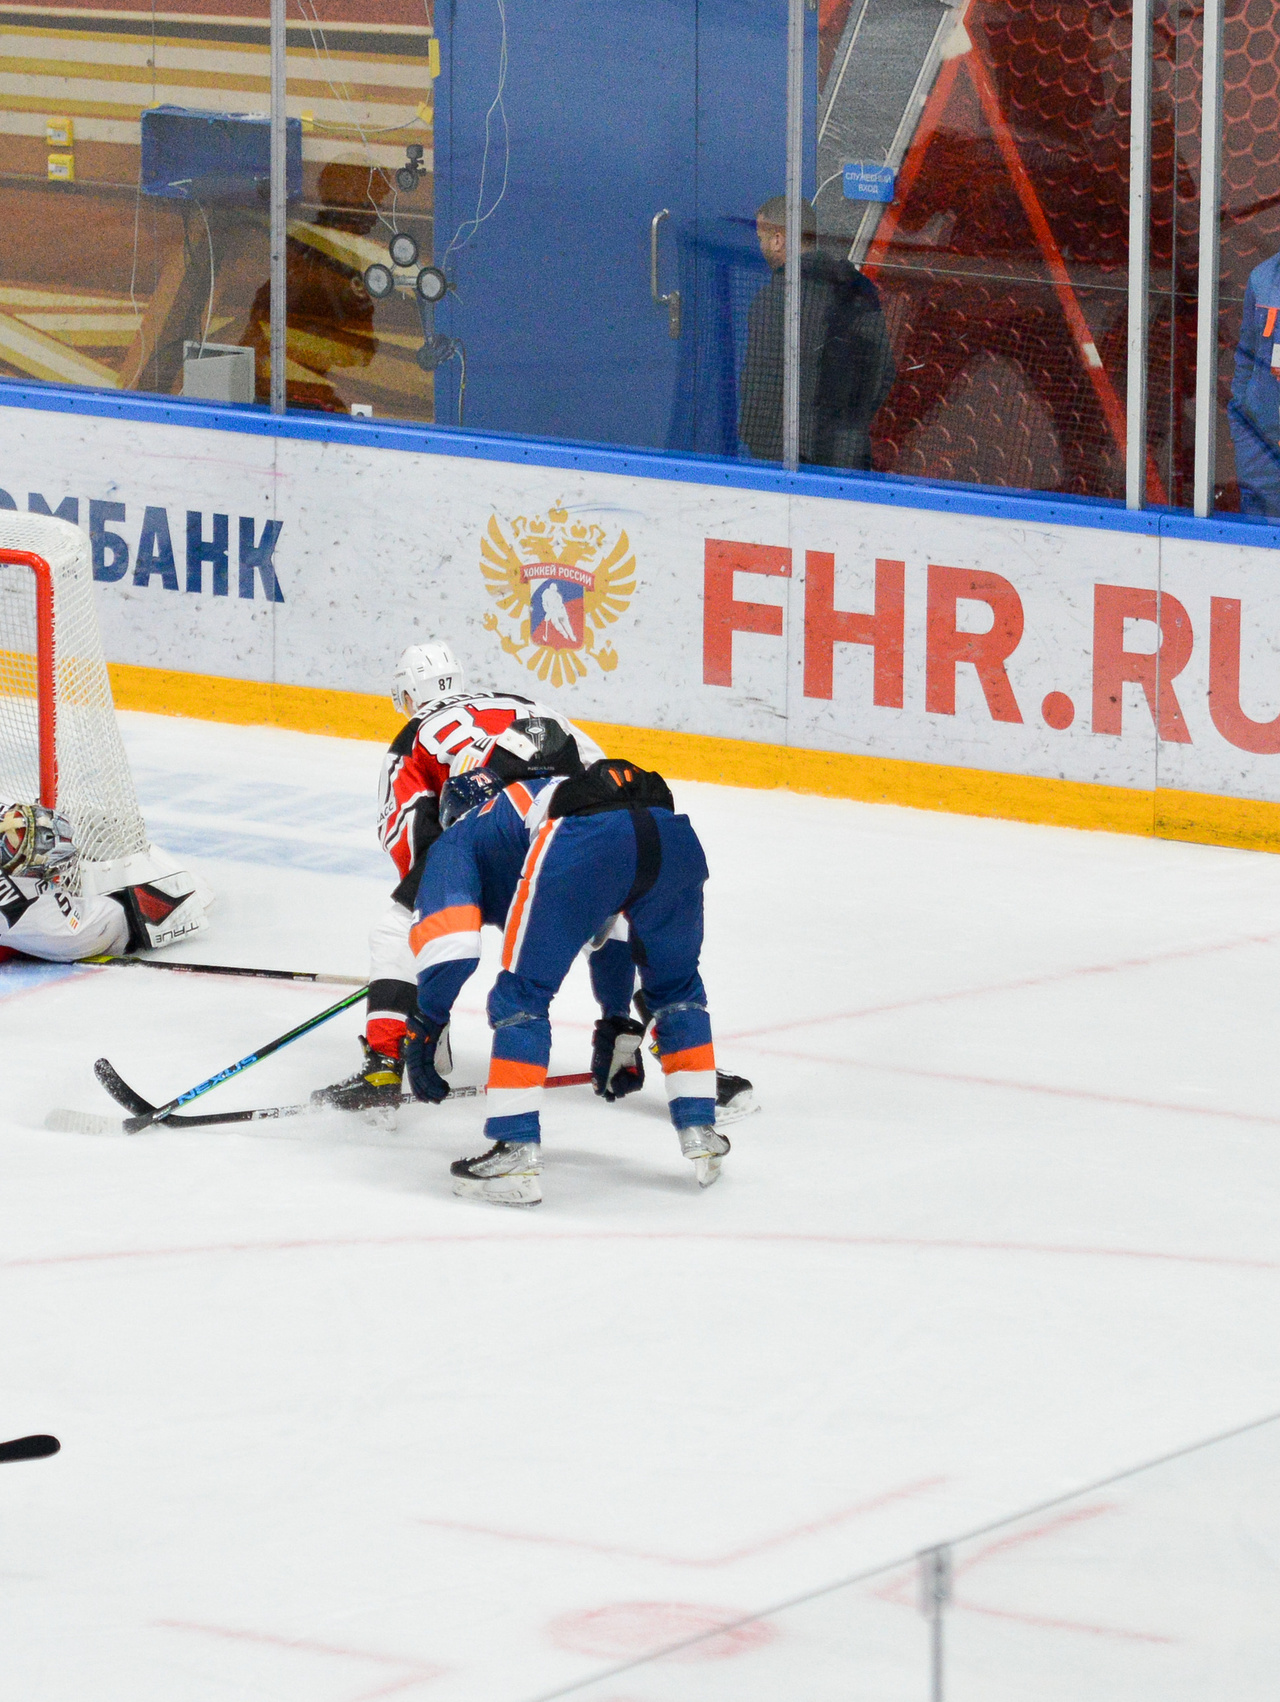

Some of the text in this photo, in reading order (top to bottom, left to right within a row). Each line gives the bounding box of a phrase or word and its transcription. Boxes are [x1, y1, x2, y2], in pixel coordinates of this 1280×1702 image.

[523, 564, 592, 586] ХОККЕЙ РОССИИ
[703, 538, 1280, 755] FHR.RU
[438, 677, 453, 691] 87
[178, 1053, 258, 1106] NEXUS
